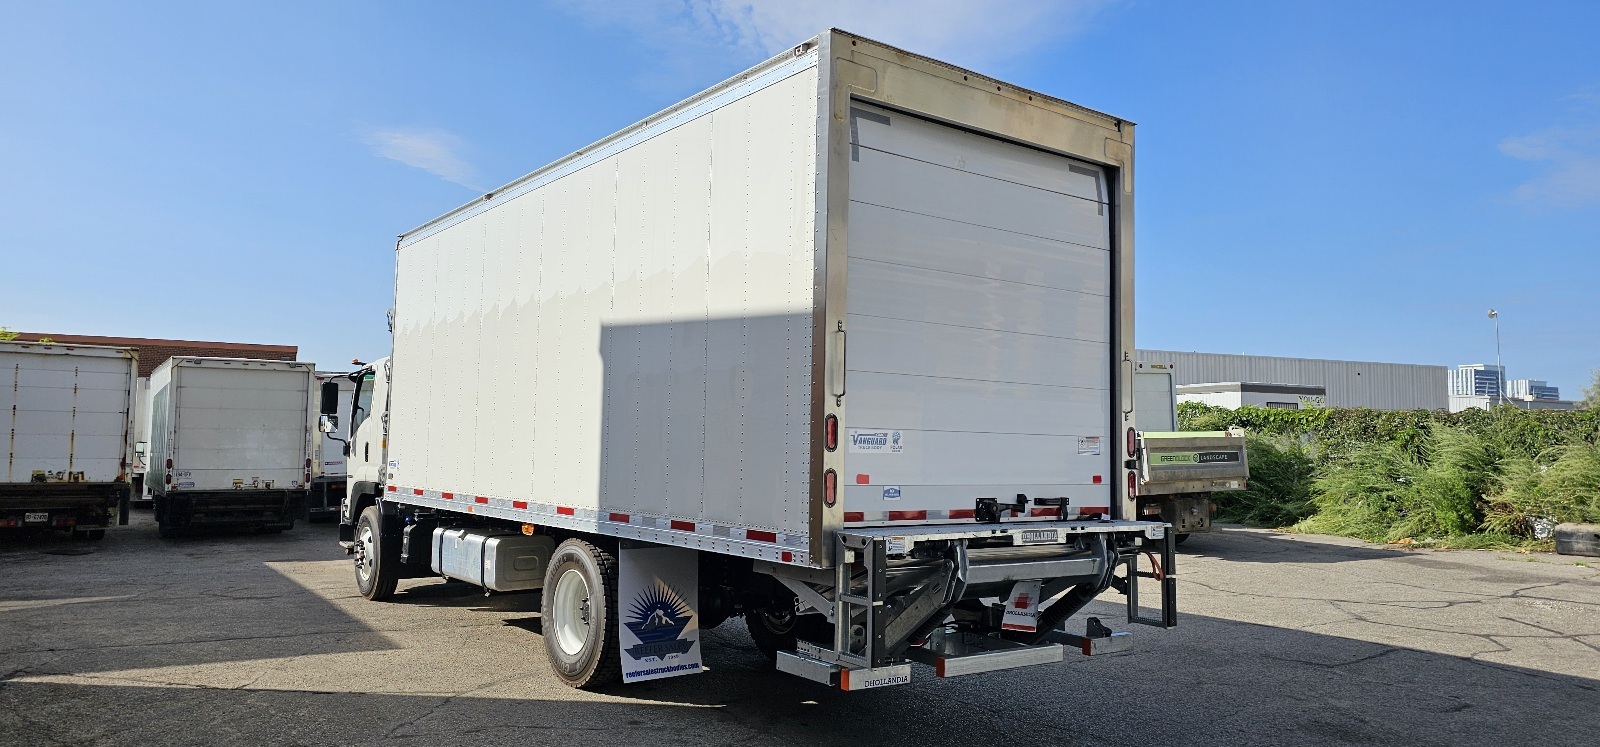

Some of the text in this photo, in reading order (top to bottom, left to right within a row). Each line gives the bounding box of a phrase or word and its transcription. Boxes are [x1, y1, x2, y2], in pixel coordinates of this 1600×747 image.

[850, 434, 887, 445] VANGUARD
[625, 663, 699, 678] reefersalestruckbodies.com
[864, 675, 908, 688] DHOLLANDIA
